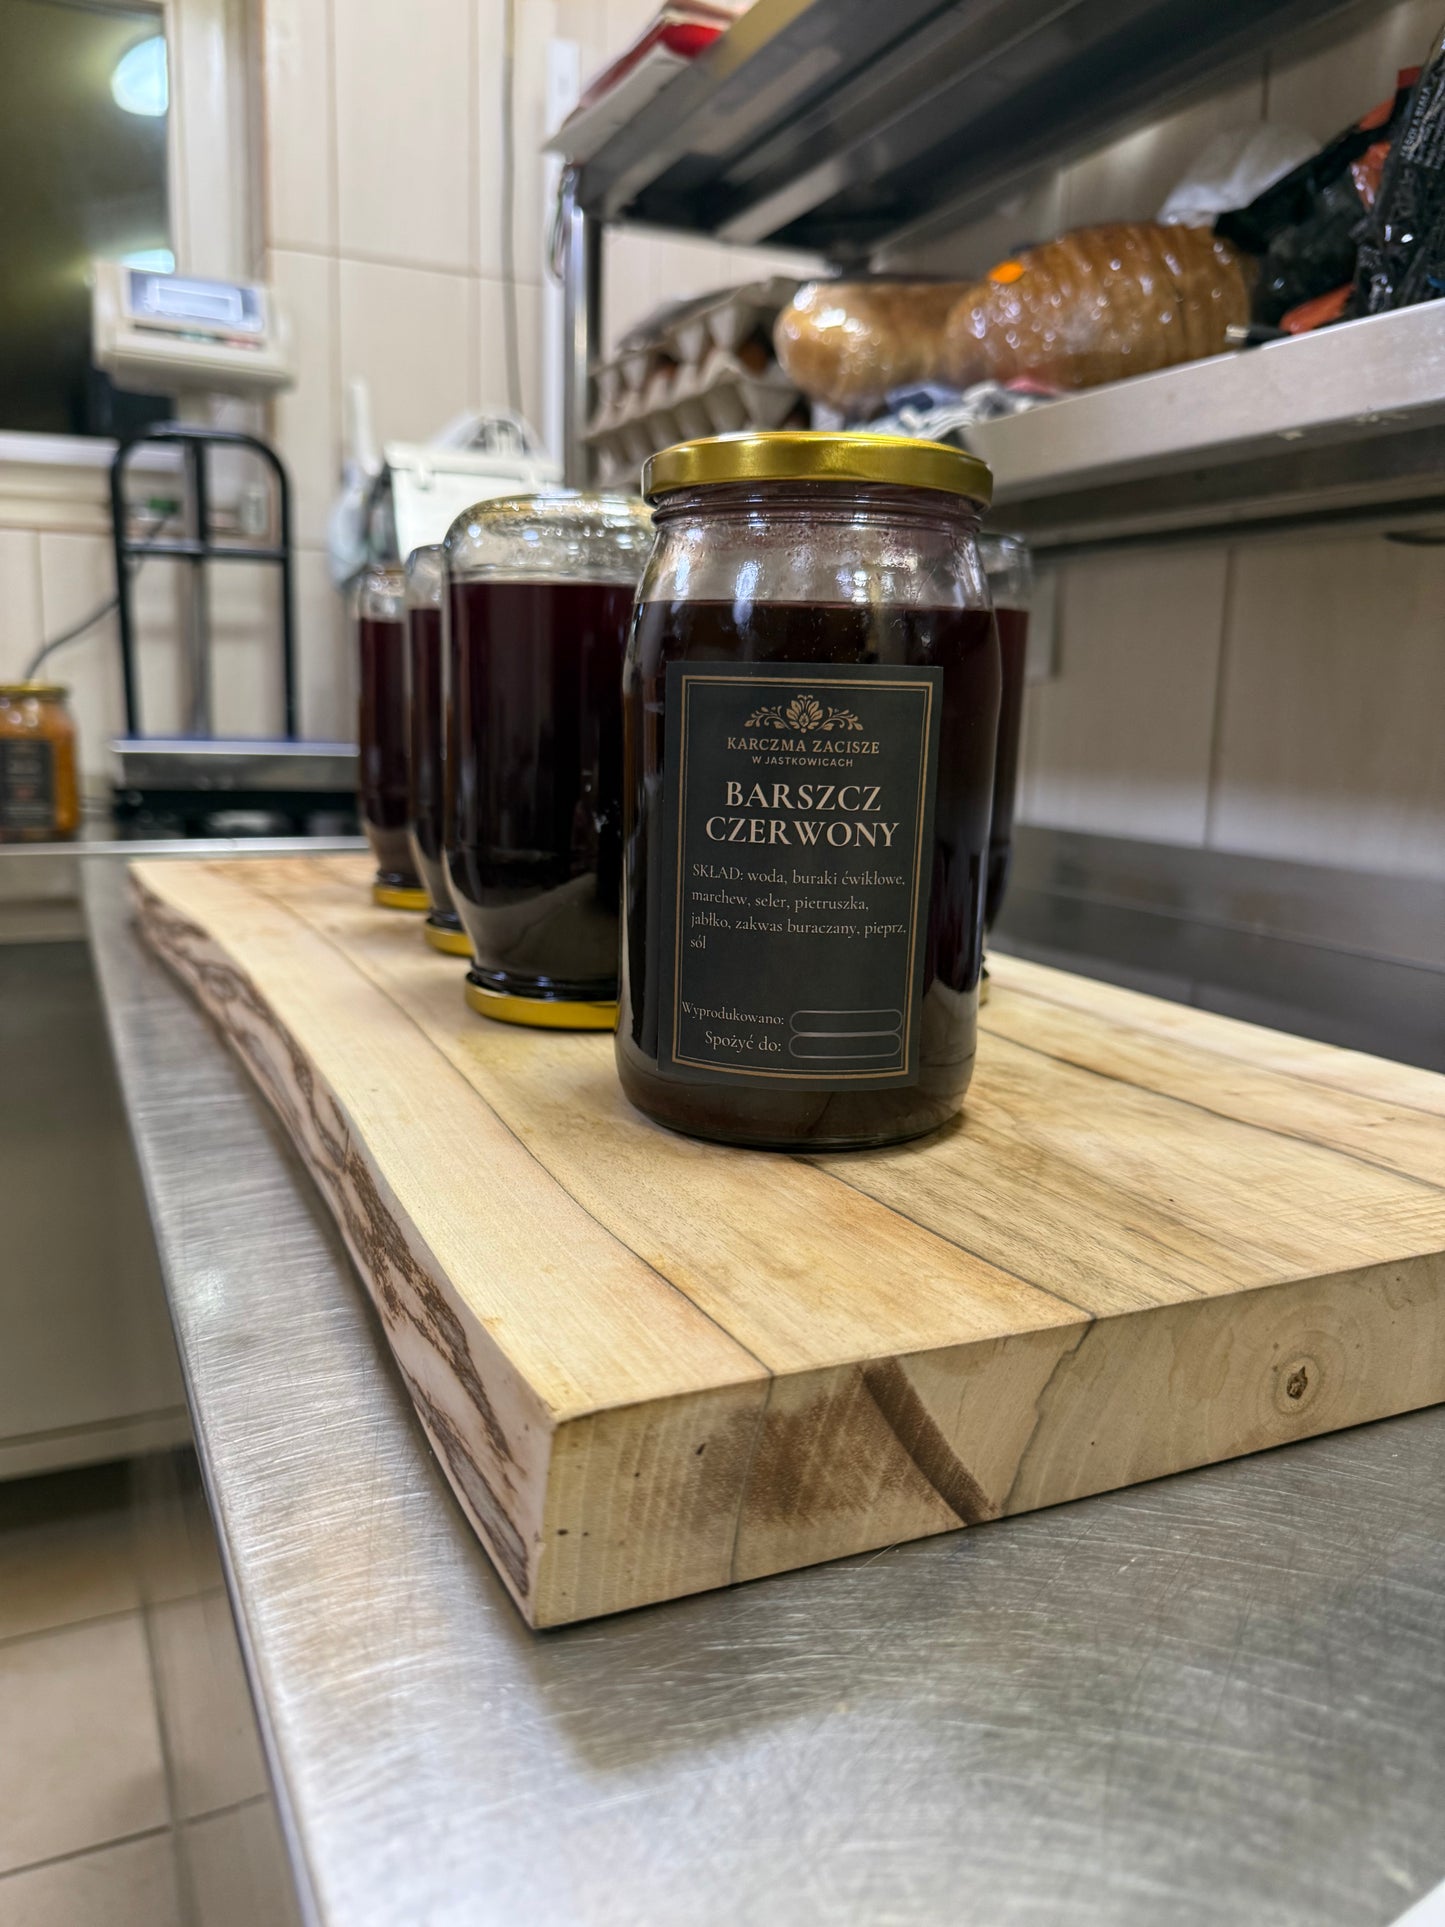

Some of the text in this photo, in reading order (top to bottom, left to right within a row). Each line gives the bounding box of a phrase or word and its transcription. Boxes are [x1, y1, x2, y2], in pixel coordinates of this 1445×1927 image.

[727, 737, 880, 754] KARCZMA ZACISZE
[752, 756, 853, 767] W JASTKOWICACH
[725, 781, 882, 812] BARSZCZ
[705, 816, 900, 847] CZERWONY
[747, 868, 788, 884] woda,
[792, 869, 838, 885] buraki
[691, 889, 751, 907] marchew,
[690, 911, 732, 929] jabłko,
[735, 916, 783, 932] zakwas
[690, 934, 706, 949] sól
[681, 1001, 784, 1025] Wyprodukowano:
[705, 1031, 782, 1053] Spożyć do:
